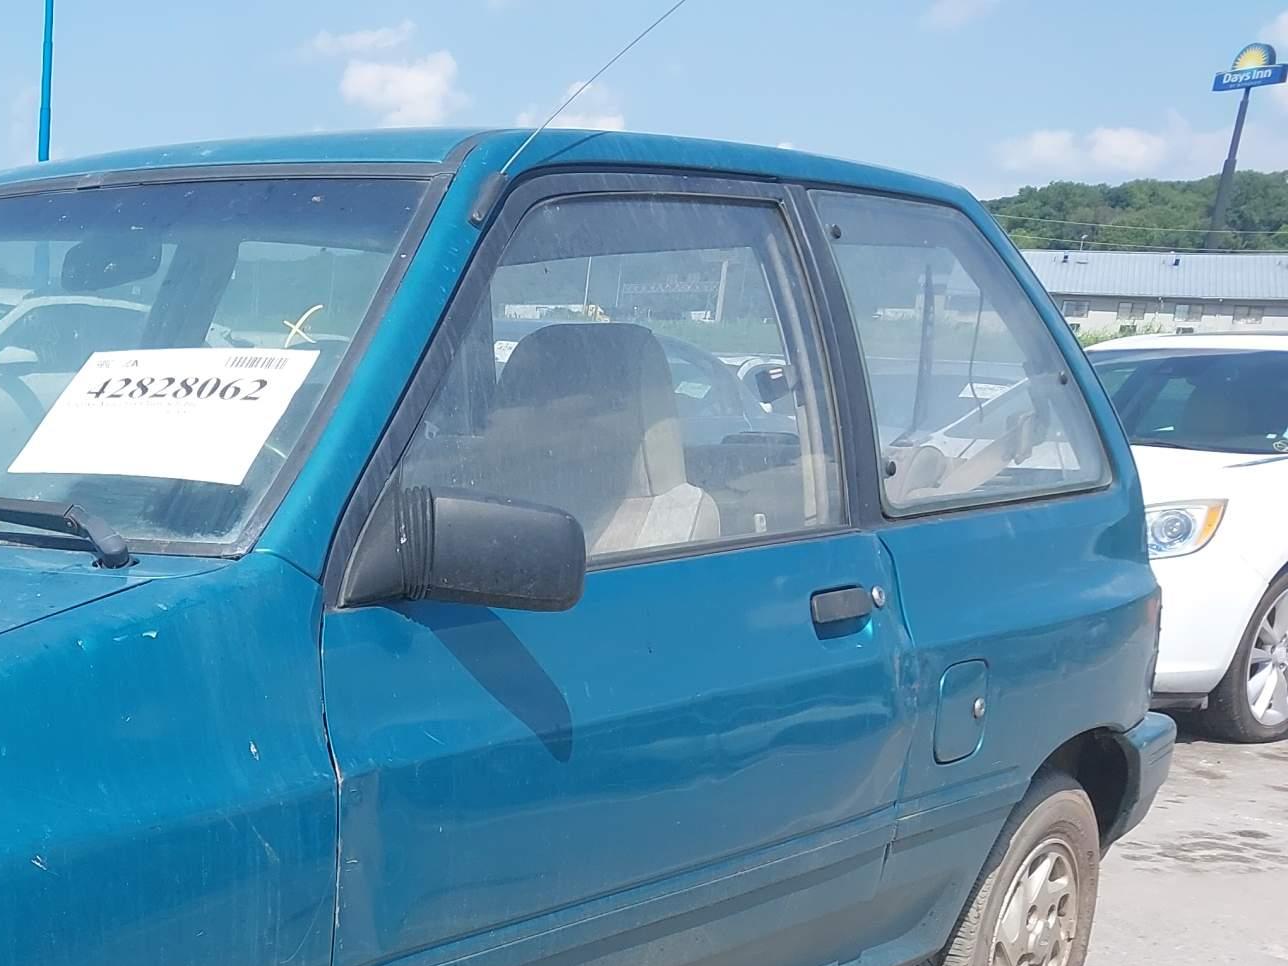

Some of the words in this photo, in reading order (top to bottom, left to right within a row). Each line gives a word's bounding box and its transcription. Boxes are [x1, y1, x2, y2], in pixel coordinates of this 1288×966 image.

[1223, 72, 1251, 84] Days
[1252, 69, 1272, 80] Inn
[86, 376, 268, 401] 42828062
